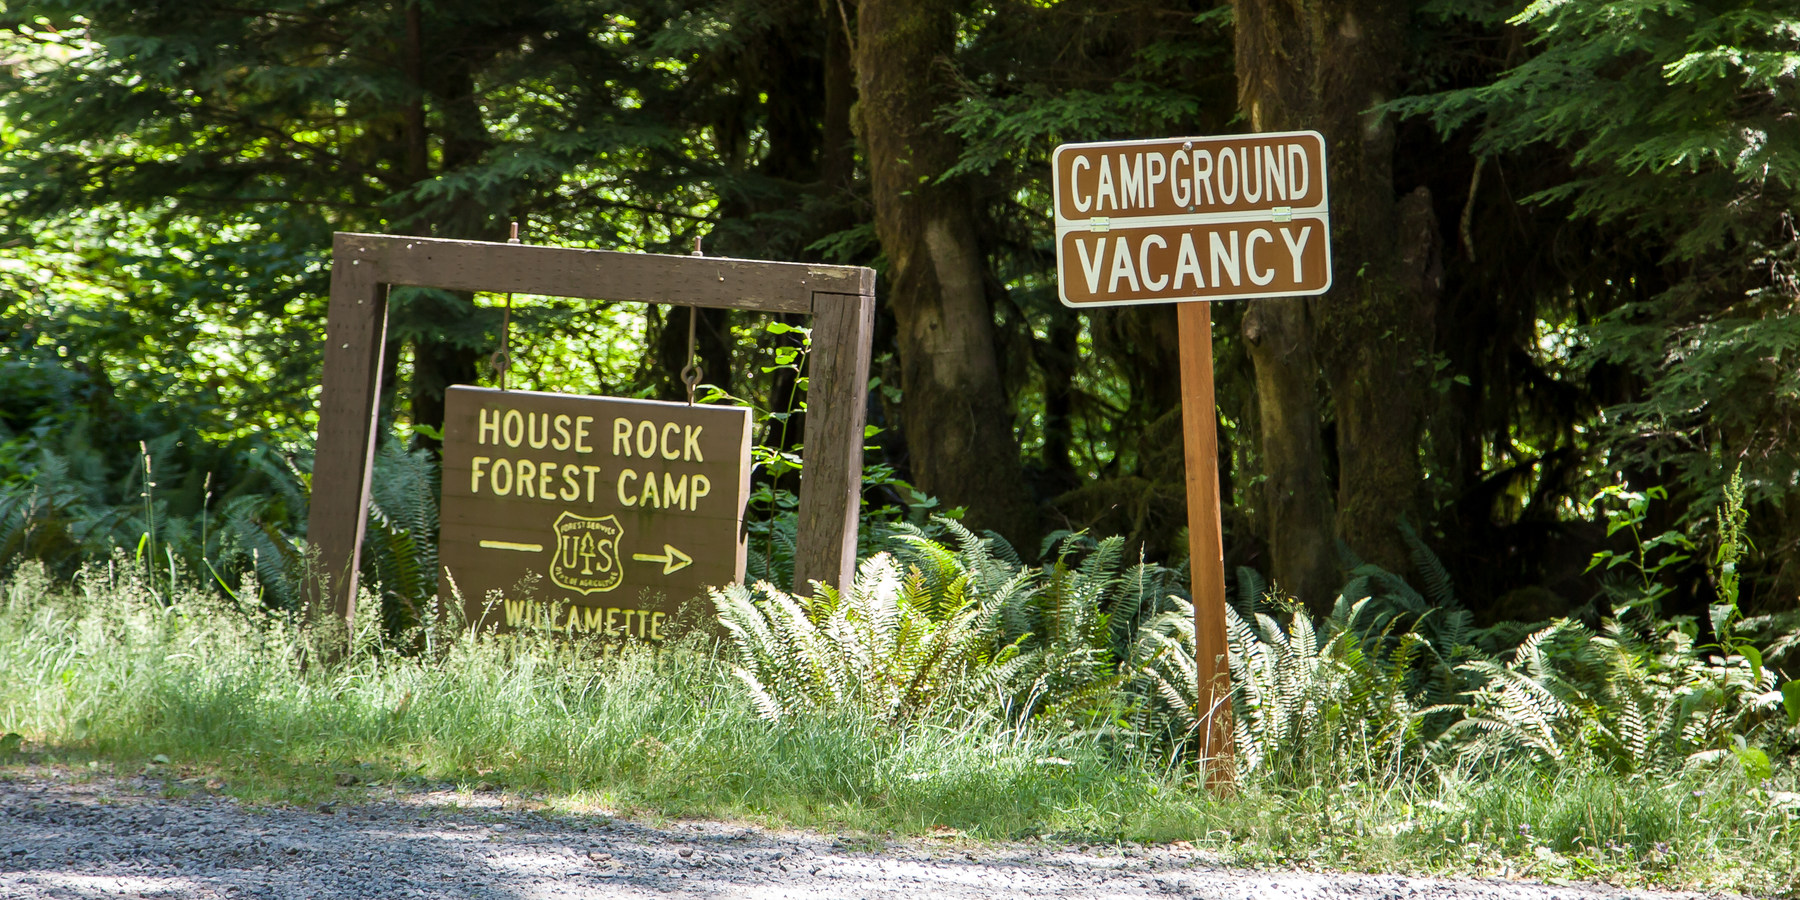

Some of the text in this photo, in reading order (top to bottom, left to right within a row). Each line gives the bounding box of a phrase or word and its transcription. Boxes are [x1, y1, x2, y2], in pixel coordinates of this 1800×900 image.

[1071, 143, 1309, 213] CAMPGROUND
[1075, 226, 1312, 294] VACANCY
[478, 408, 704, 463] HOUSE ROCK
[471, 456, 711, 511] FOREST CAMP
[504, 598, 666, 640] WILLAMETTE
